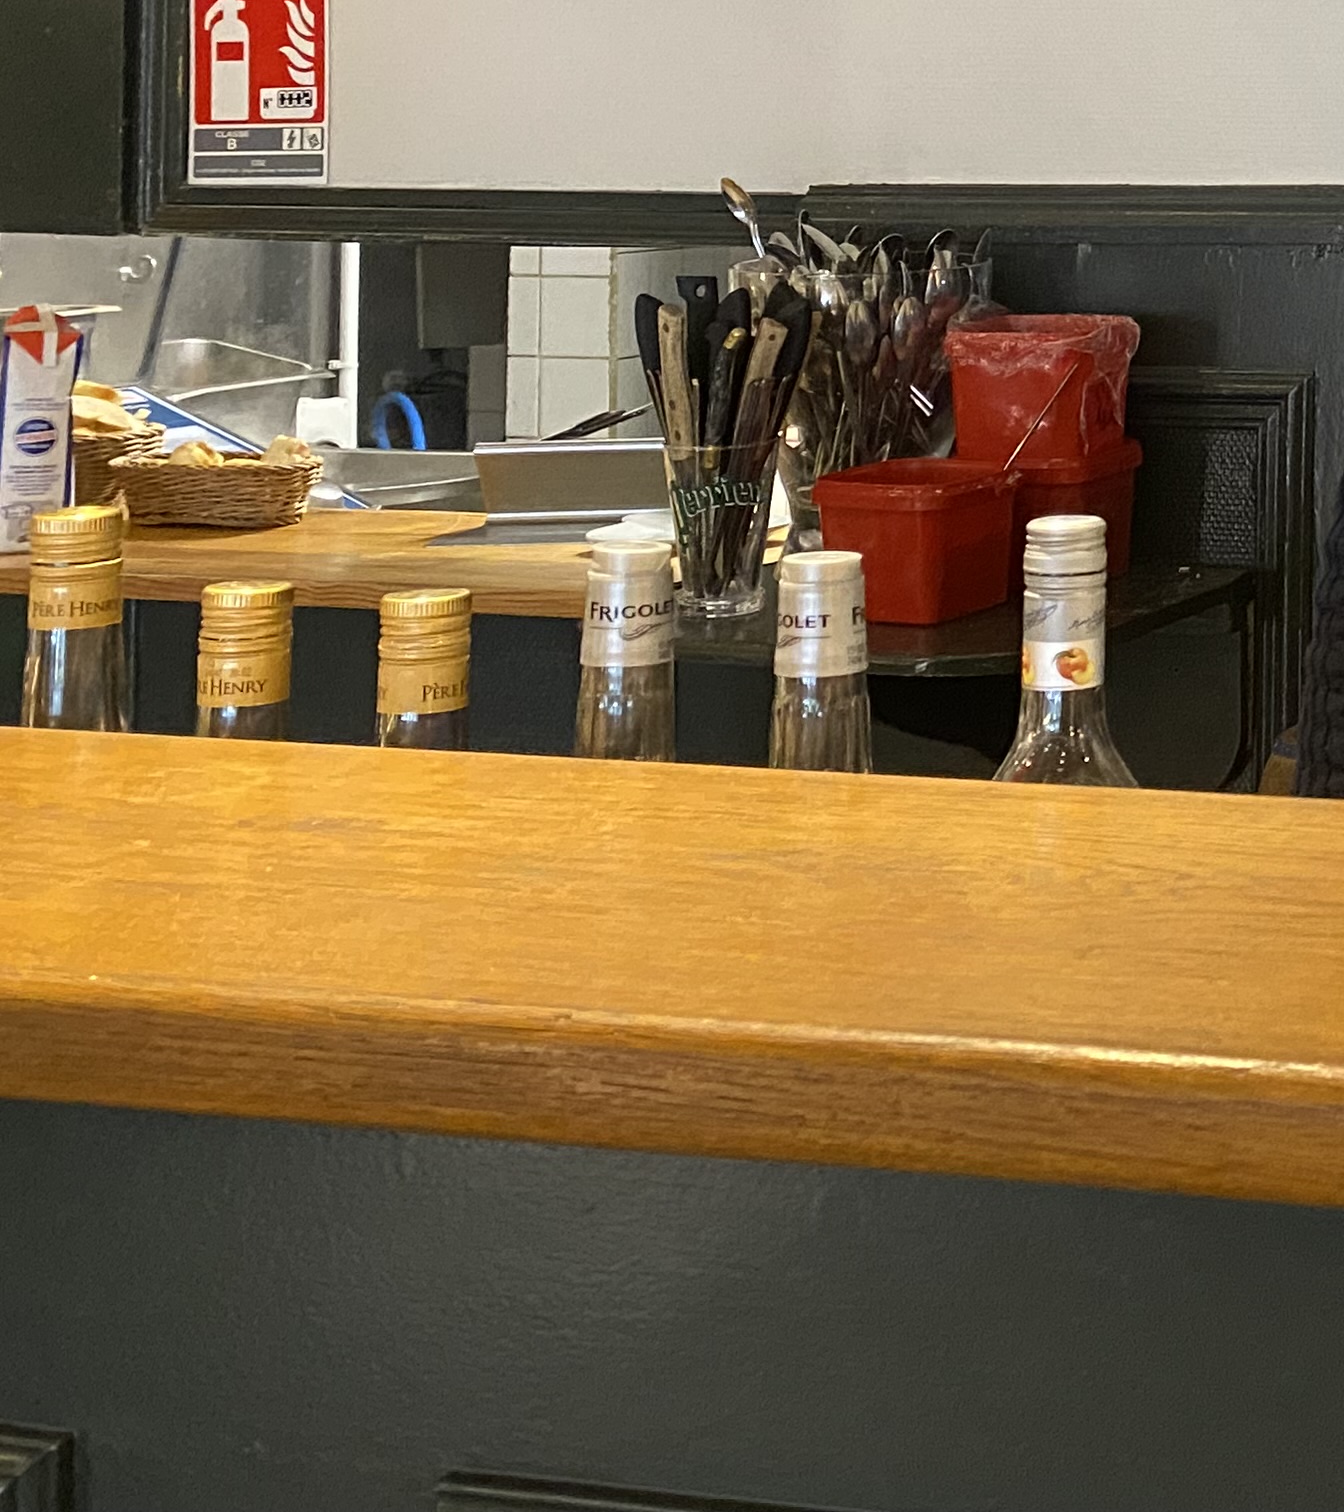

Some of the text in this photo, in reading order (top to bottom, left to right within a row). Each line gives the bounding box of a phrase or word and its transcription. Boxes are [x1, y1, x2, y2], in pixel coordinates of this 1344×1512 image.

[226, 138, 238, 150] B
[31, 599, 66, 619] PÈRE
[590, 598, 674, 624] FRIGOLE
[210, 678, 269, 696] HENRY
[421, 682, 459, 702] PÈRE
